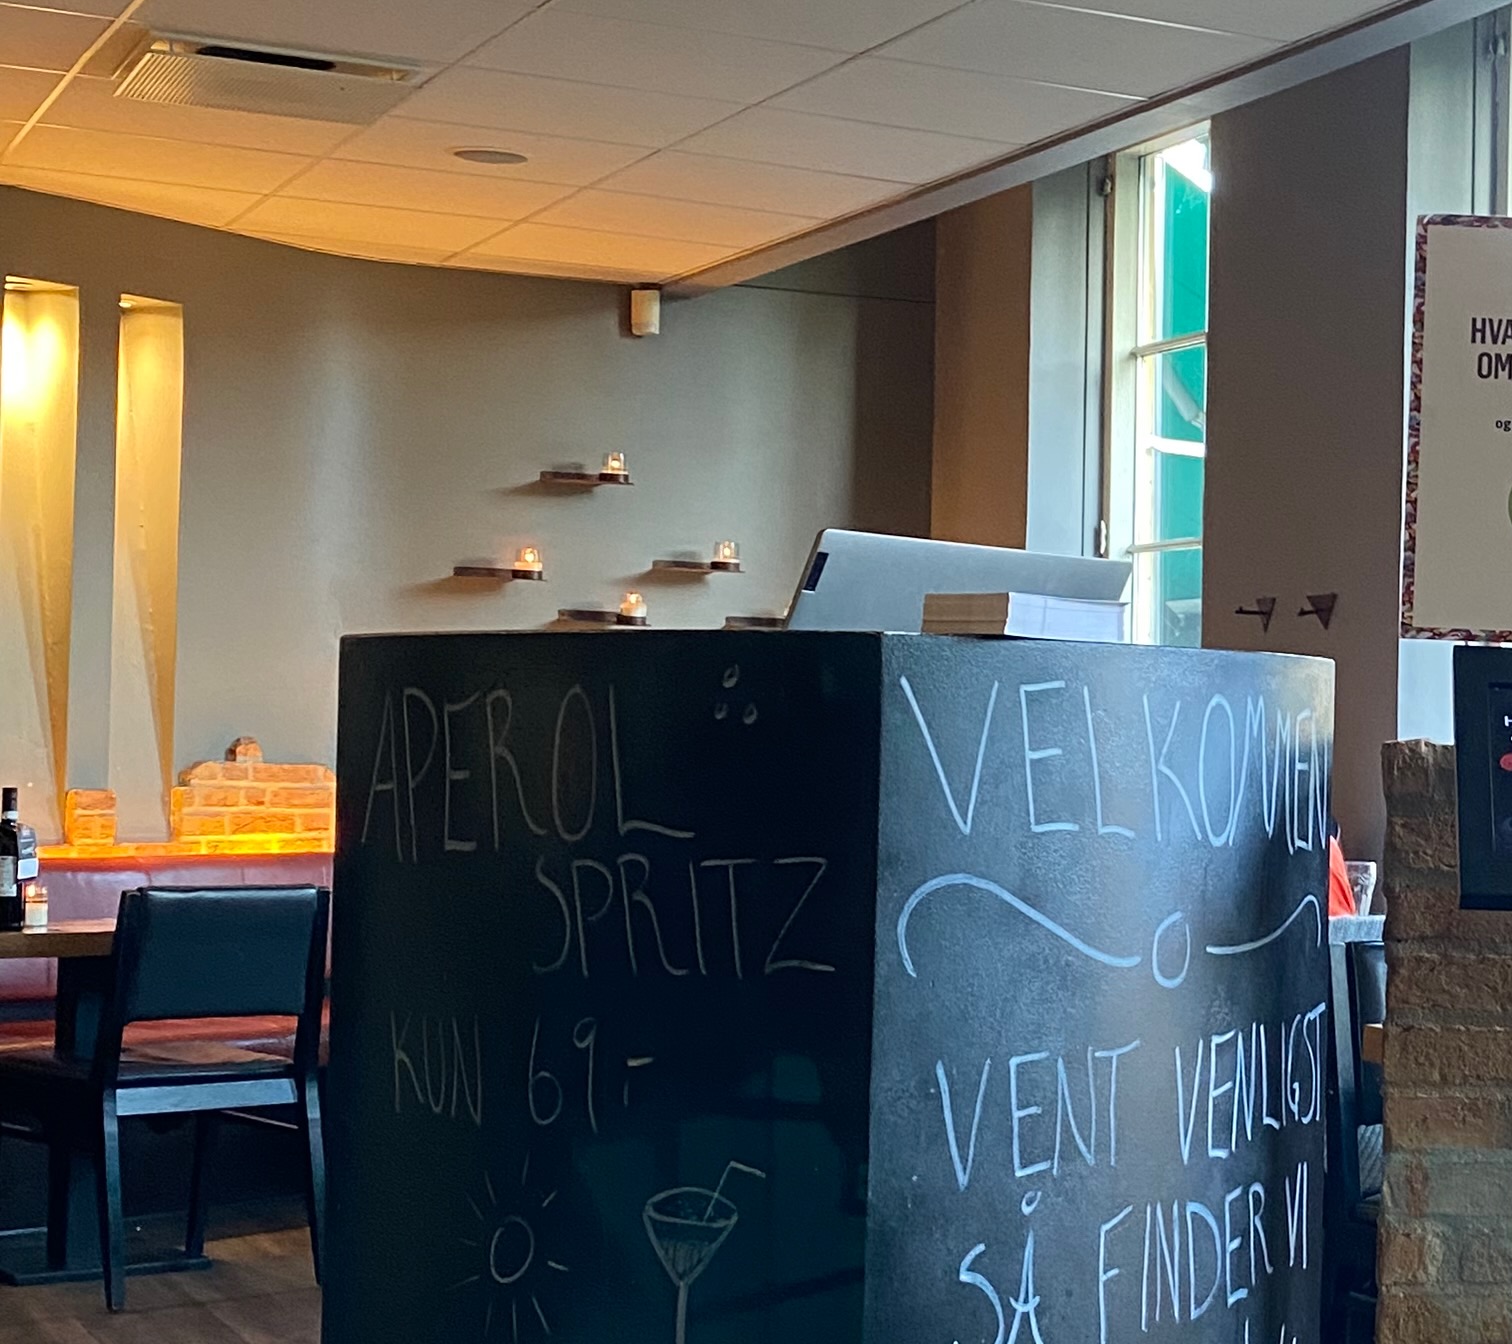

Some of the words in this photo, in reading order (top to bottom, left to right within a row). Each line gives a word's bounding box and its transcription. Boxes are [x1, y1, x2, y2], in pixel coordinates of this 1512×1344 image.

[1495, 420, 1512, 433] og
[361, 682, 697, 864] APEROL
[899, 674, 1333, 856] VELKOMMEN
[532, 852, 837, 981] SPRITZ
[389, 1009, 483, 1127] KUN
[934, 1039, 1141, 1193] VENT
[1175, 1001, 1327, 1167] VENLIGST
[1284, 1161, 1310, 1271] VI
